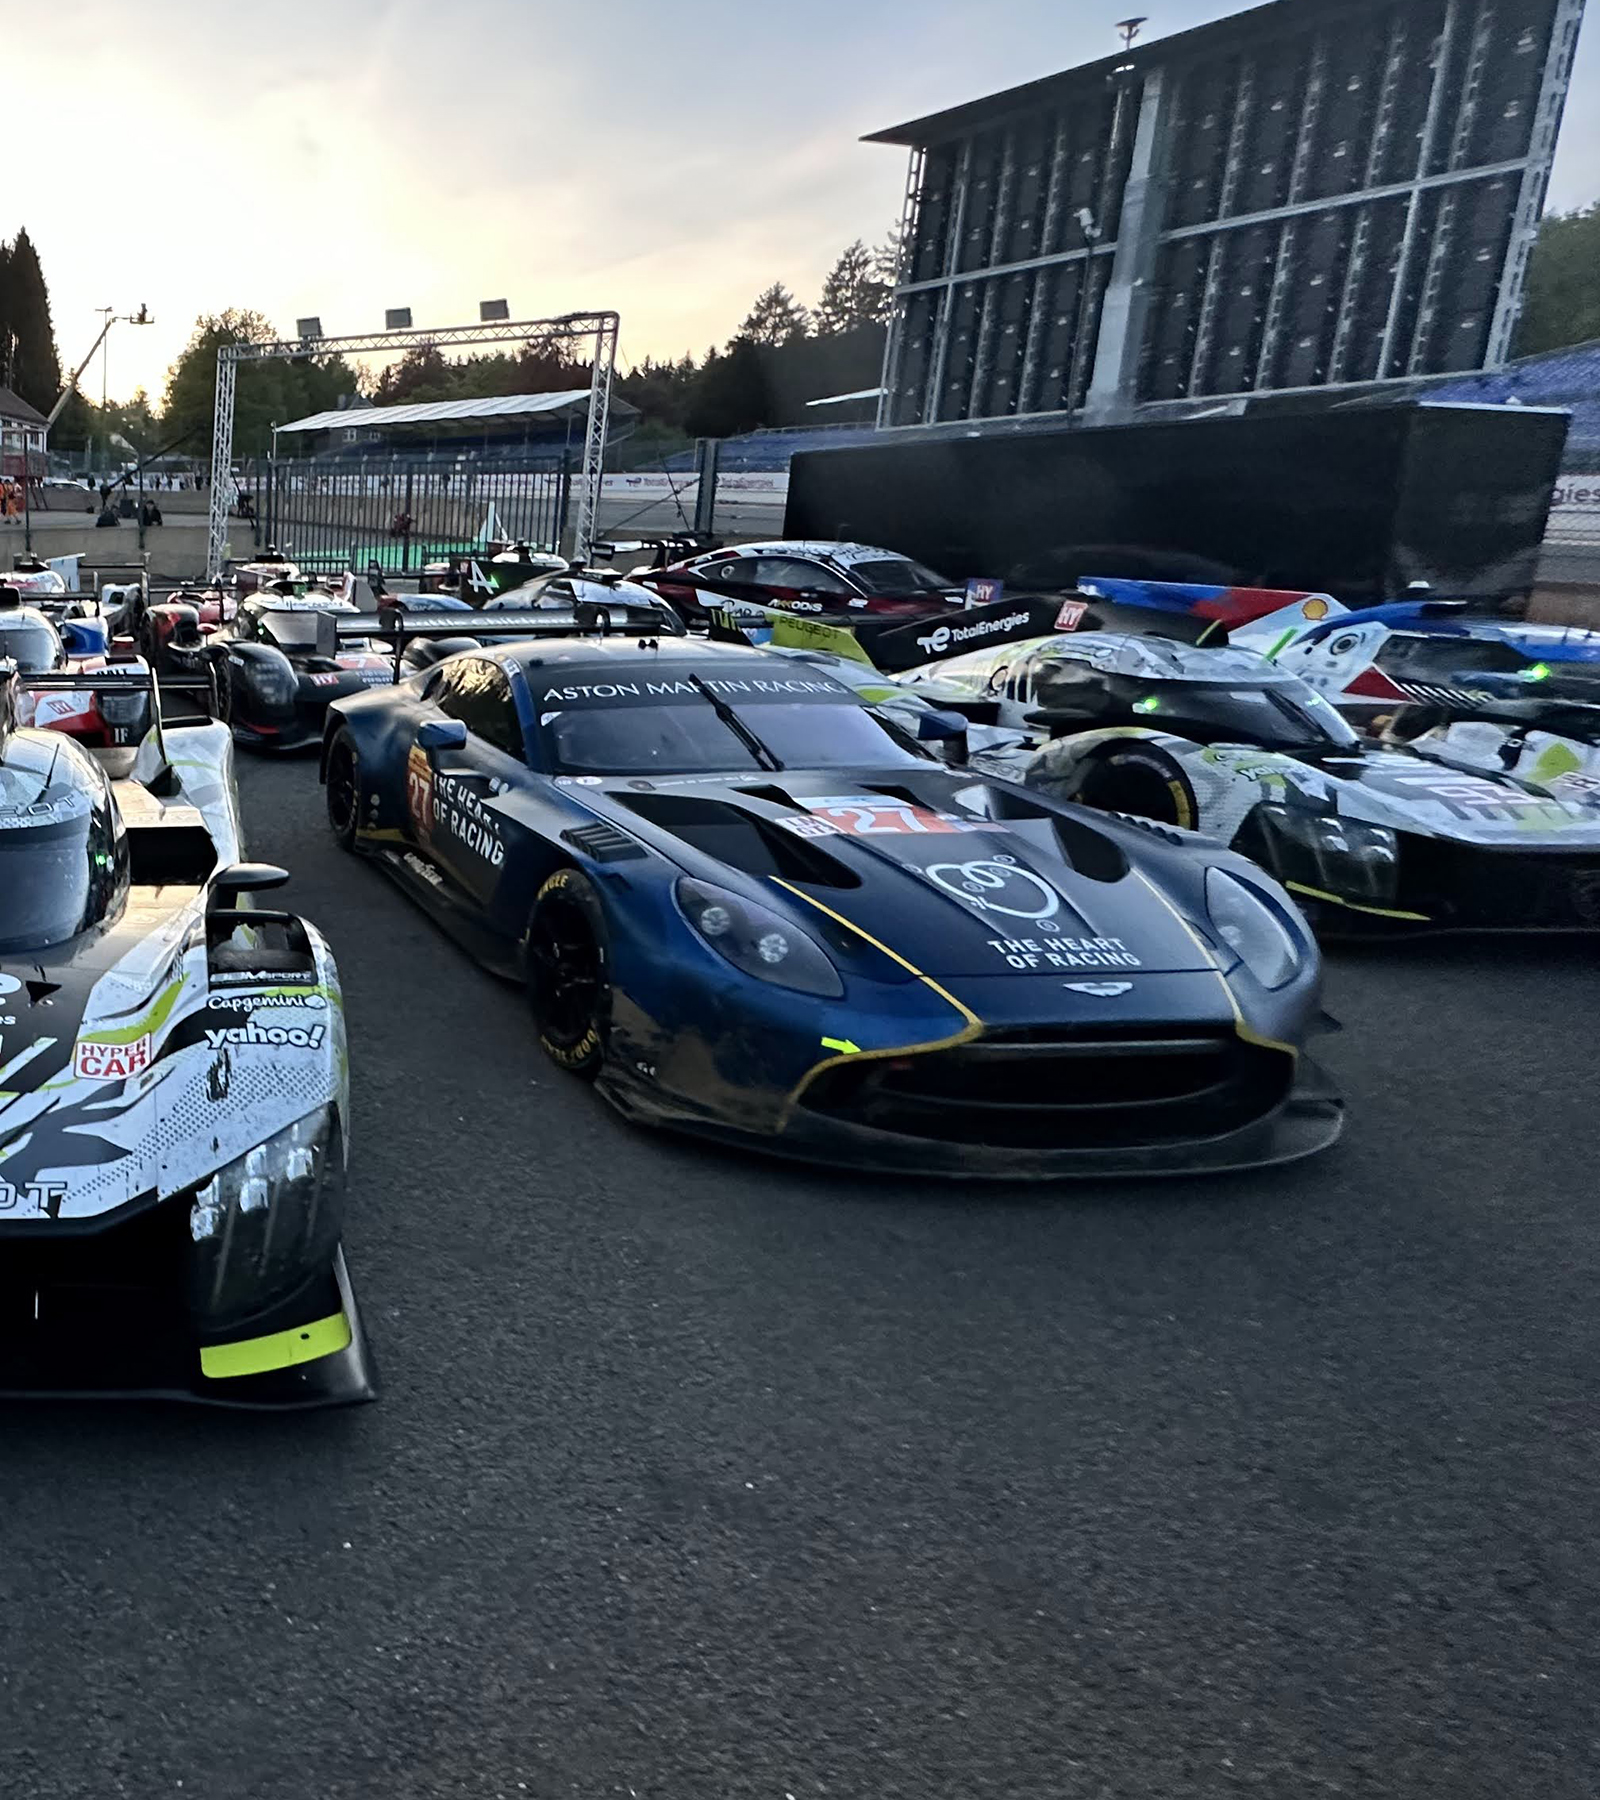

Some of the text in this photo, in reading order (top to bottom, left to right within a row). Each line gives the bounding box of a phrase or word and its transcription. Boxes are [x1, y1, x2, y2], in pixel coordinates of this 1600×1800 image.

[975, 584, 994, 600] HY
[1058, 606, 1084, 626] HY
[951, 612, 1030, 642] TotalEnergies
[543, 683, 639, 701] ASTON
[752, 680, 849, 695] RACING
[409, 771, 431, 825] 27
[827, 805, 930, 834] 27
[433, 797, 505, 866] OF RACING
[986, 937, 1128, 955] THE HEART
[1005, 951, 1142, 970] OF RACING
[207, 994, 306, 1012] Capgemini
[204, 1021, 325, 1049] yahoo!
[81, 1041, 148, 1057] HYPER
[80, 1053, 147, 1077] CAR
